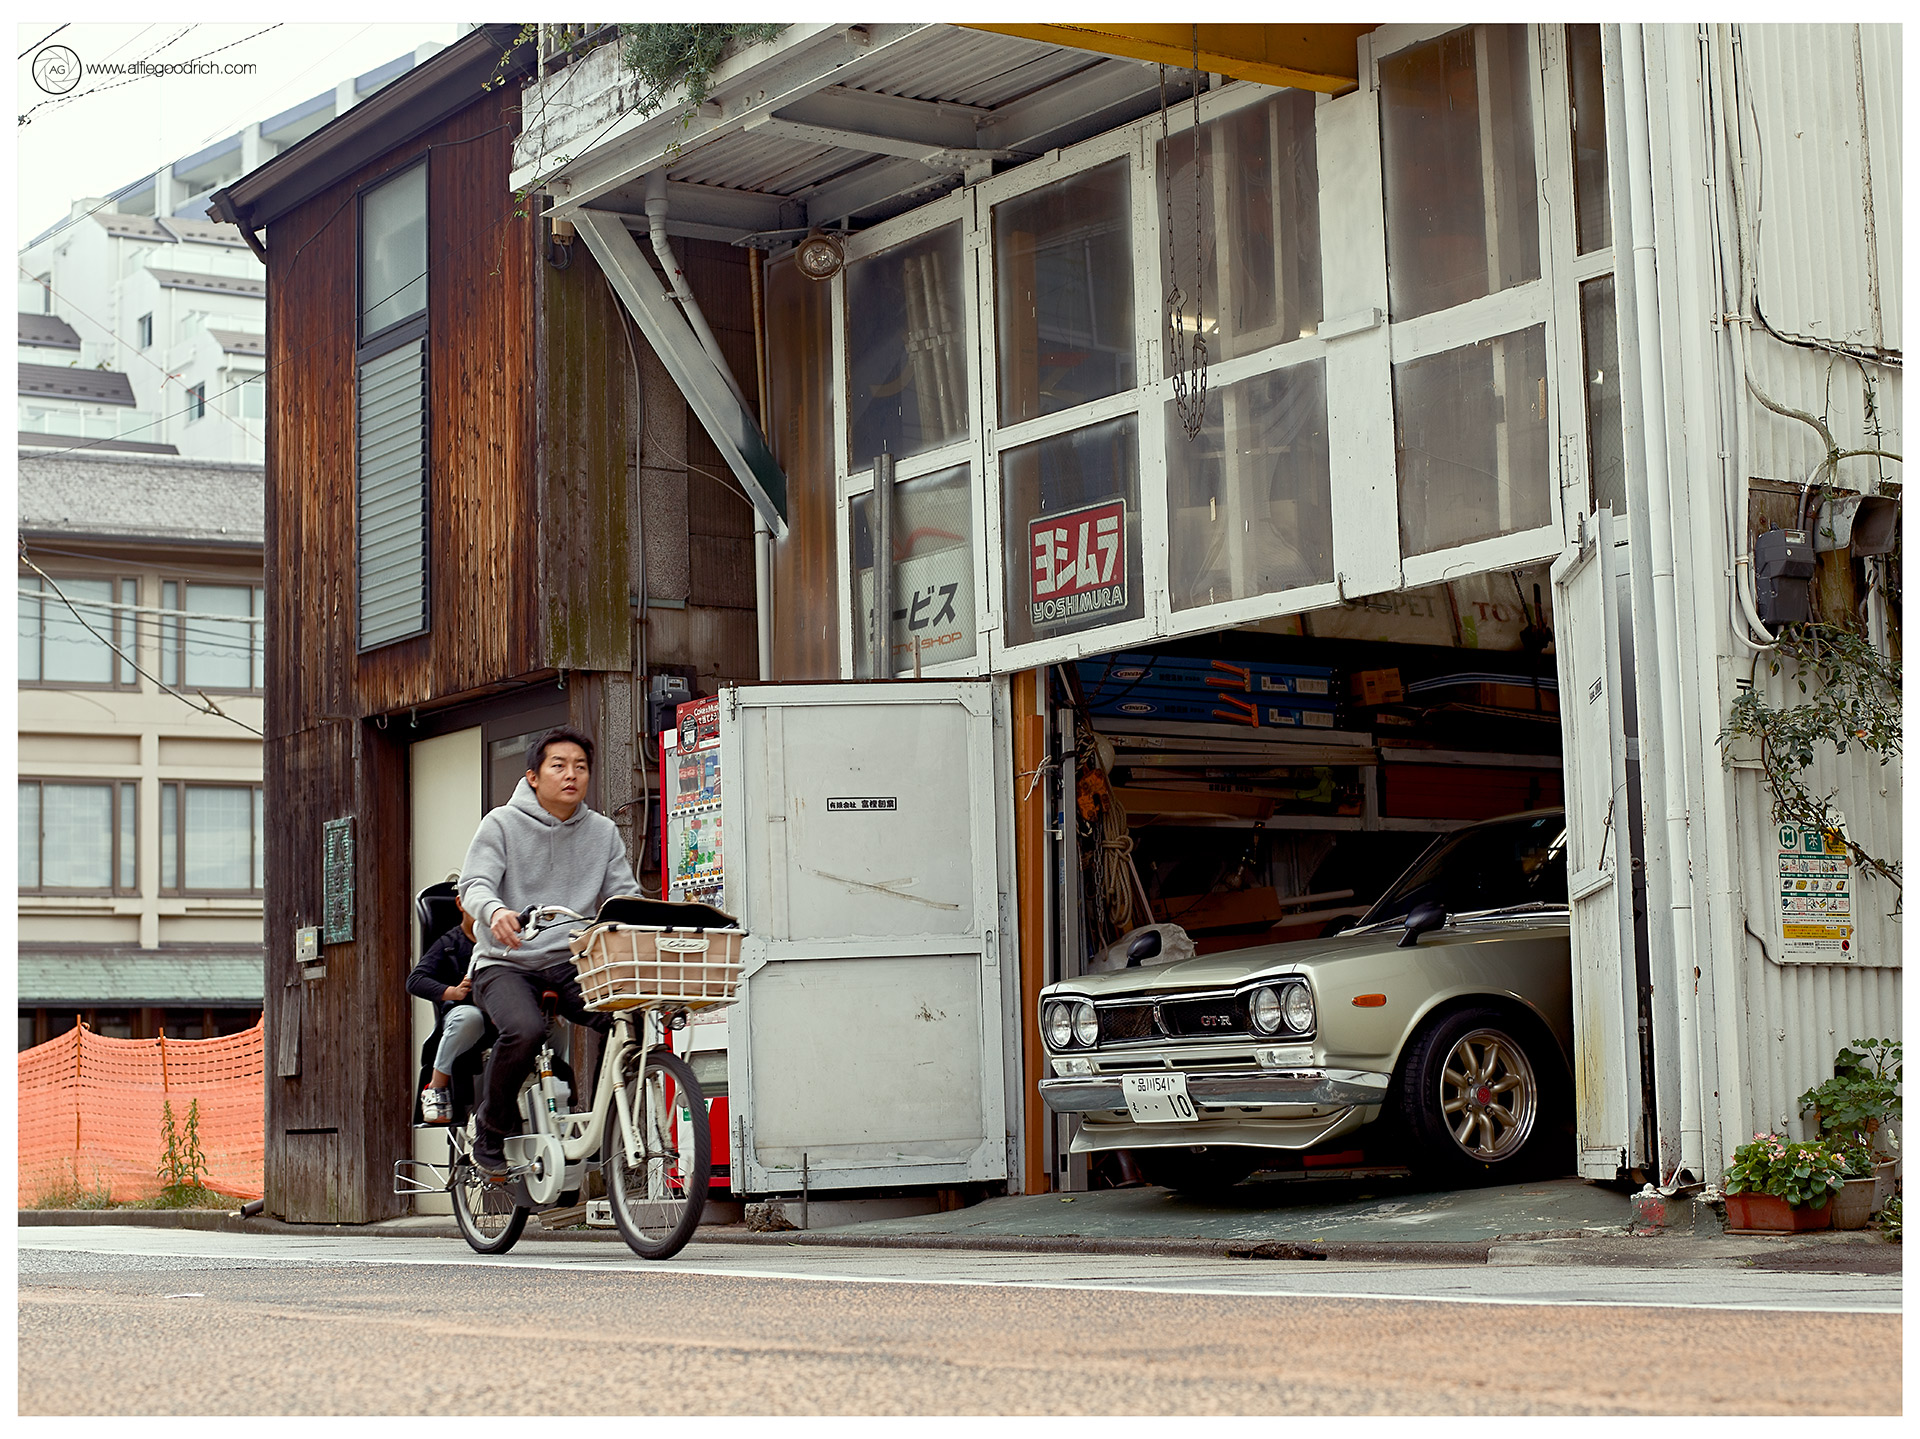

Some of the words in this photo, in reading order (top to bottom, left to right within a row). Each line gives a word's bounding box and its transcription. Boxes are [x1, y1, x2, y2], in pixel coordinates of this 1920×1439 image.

[1034, 515, 1119, 596] ヨシムラ
[868, 582, 959, 642] ービス
[1032, 585, 1124, 623] YOSHIMURA
[921, 631, 963, 650] SHOP
